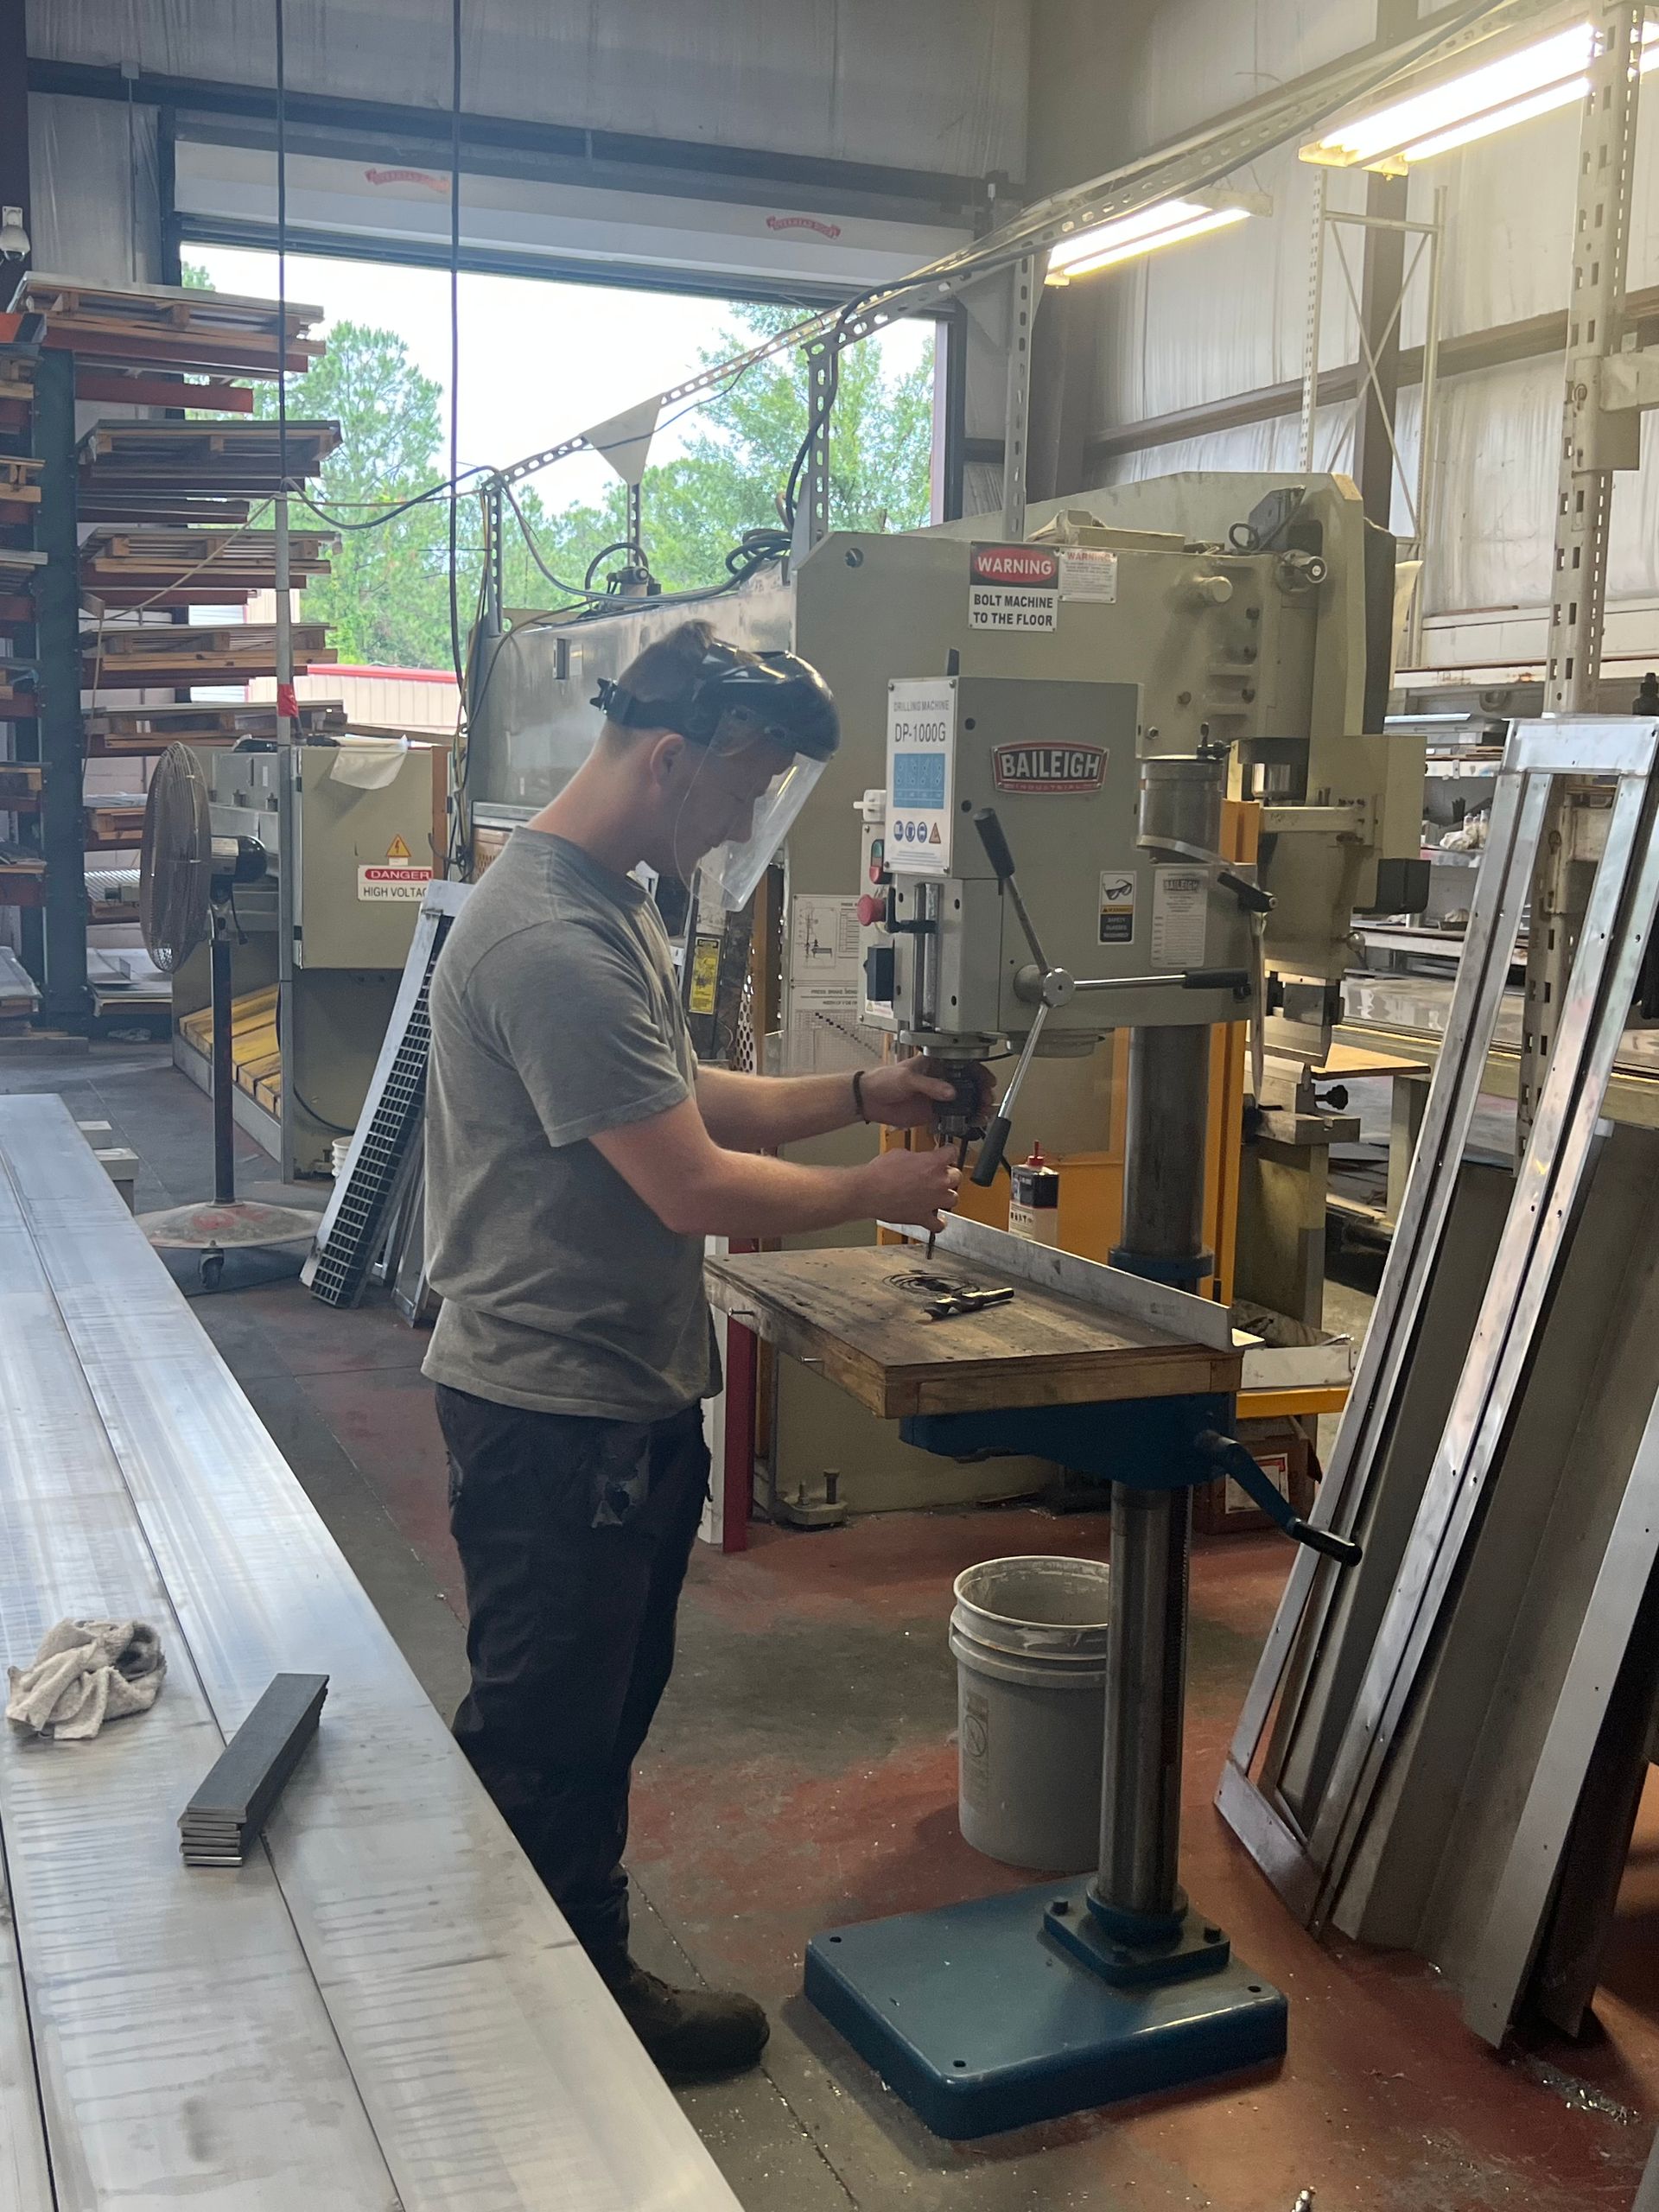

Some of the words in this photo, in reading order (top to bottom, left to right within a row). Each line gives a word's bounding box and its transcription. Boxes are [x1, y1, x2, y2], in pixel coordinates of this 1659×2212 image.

[1067, 551, 1111, 563] WARNING
[977, 556, 1052, 575] WARNING
[974, 594, 1001, 607] BOLT
[1004, 595, 1053, 608] MACHINE
[973, 612, 988, 623] TO
[991, 613, 1014, 625] THE
[1016, 613, 1052, 626] FLOOR
[893, 701, 921, 712] DRILLING
[921, 700, 950, 711] MACHINE
[894, 721, 946, 742] DP-1000G
[1001, 750, 1100, 778] BAILEIGH
[371, 870, 429, 880] DANGER
[363, 887, 388, 897] HIGH
